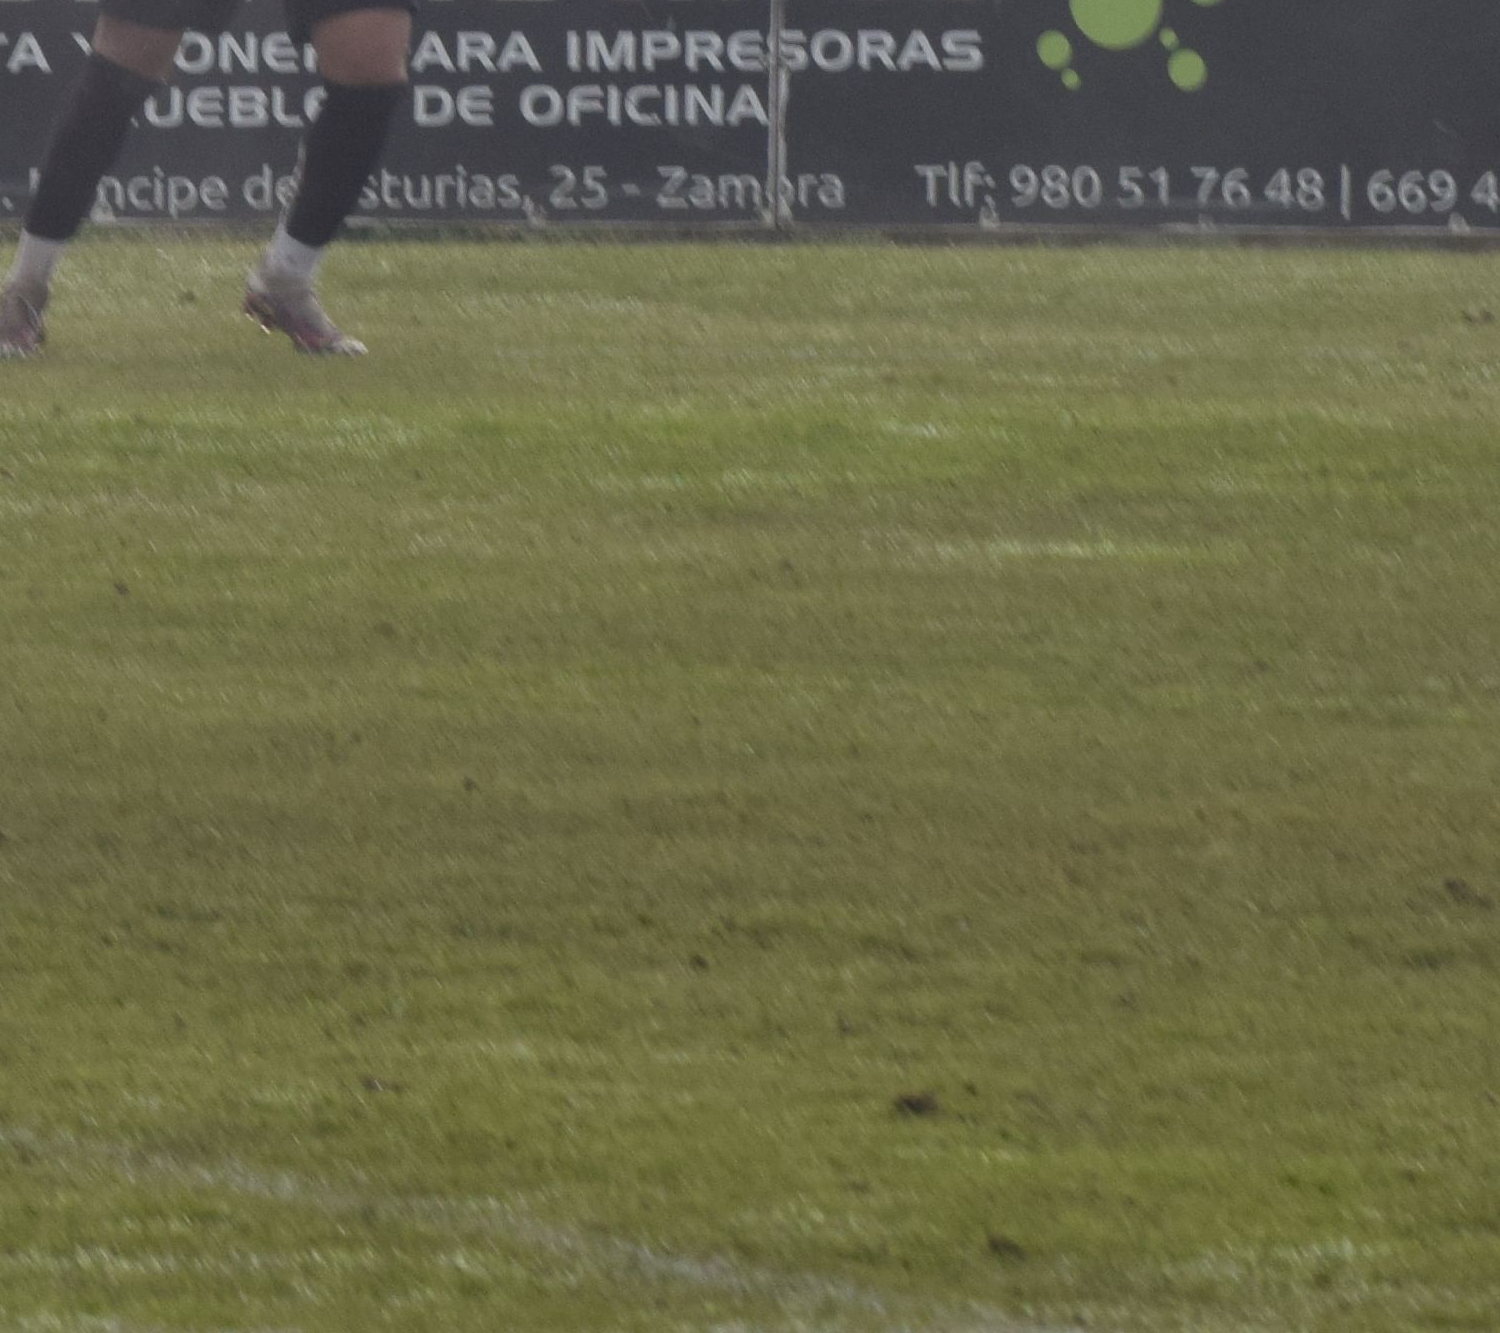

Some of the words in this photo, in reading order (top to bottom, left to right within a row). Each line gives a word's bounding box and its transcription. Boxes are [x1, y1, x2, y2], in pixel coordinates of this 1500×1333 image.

[411, 29, 542, 73] ARA
[566, 29, 986, 73] IMPRESORAS
[412, 84, 495, 127] DE
[518, 84, 770, 127] OFICINA
[547, 164, 609, 209] 25
[1009, 164, 1102, 209] 980
[1116, 165, 1171, 209] 51
[1189, 165, 1252, 210] 76
[1263, 166, 1326, 212] 48
[1366, 167, 1458, 214] 669
